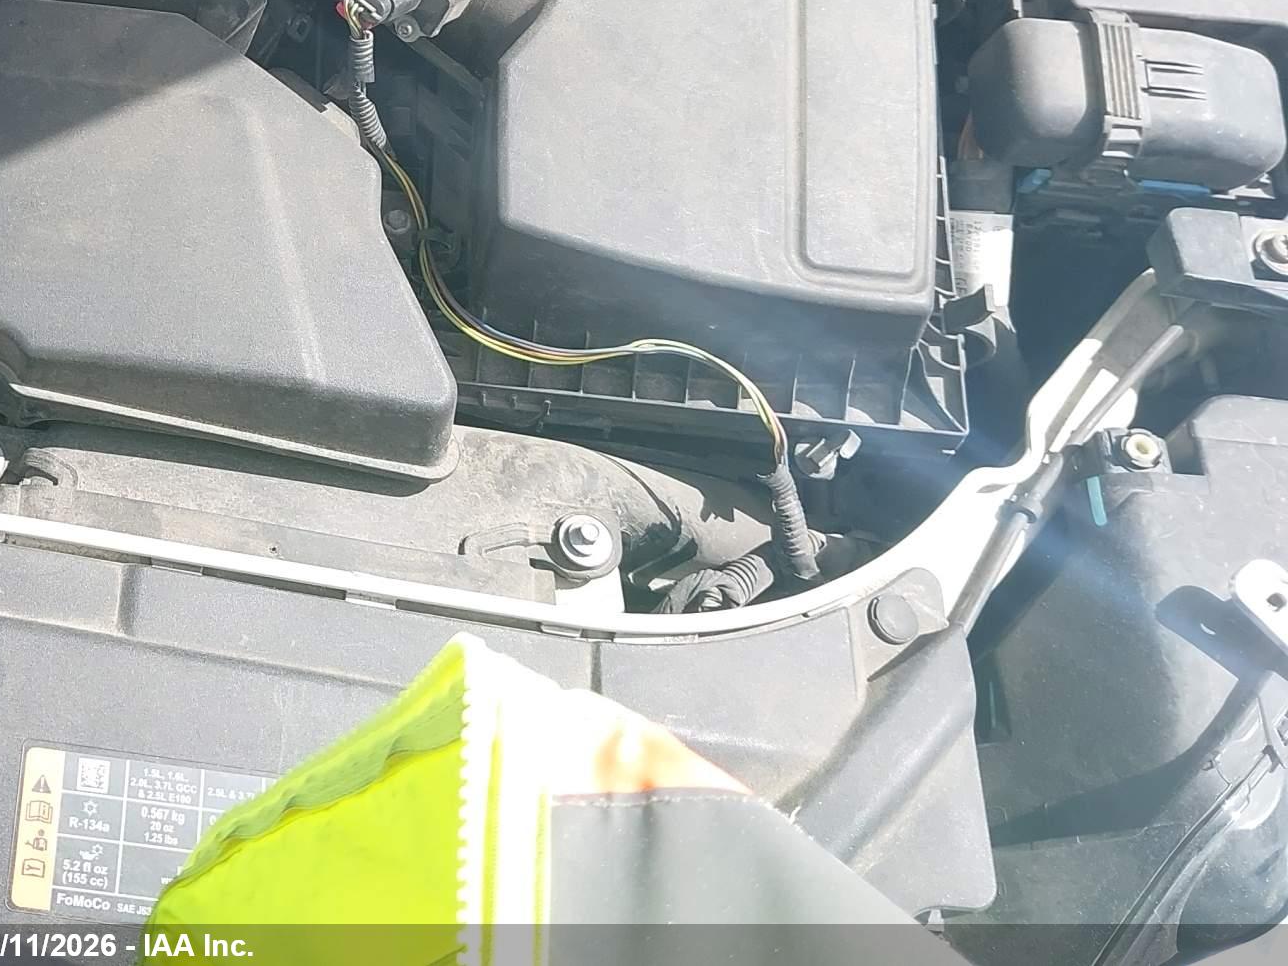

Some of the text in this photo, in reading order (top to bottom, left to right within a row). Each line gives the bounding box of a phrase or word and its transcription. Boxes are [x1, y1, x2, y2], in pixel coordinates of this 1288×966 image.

[138, 789, 145, 798] &
[175, 783, 197, 794] GCC
[141, 806, 185, 825] 0.567 kg
[68, 816, 110, 832] R-134a
[150, 821, 174, 833] 20 oz
[144, 831, 178, 845] 1.25 lbs
[63, 859, 108, 875] 5.2 fl oz
[62, 871, 108, 889] (155 cc)
[56, 893, 111, 910] FoMoCo
[117, 902, 136, 914] SAE
